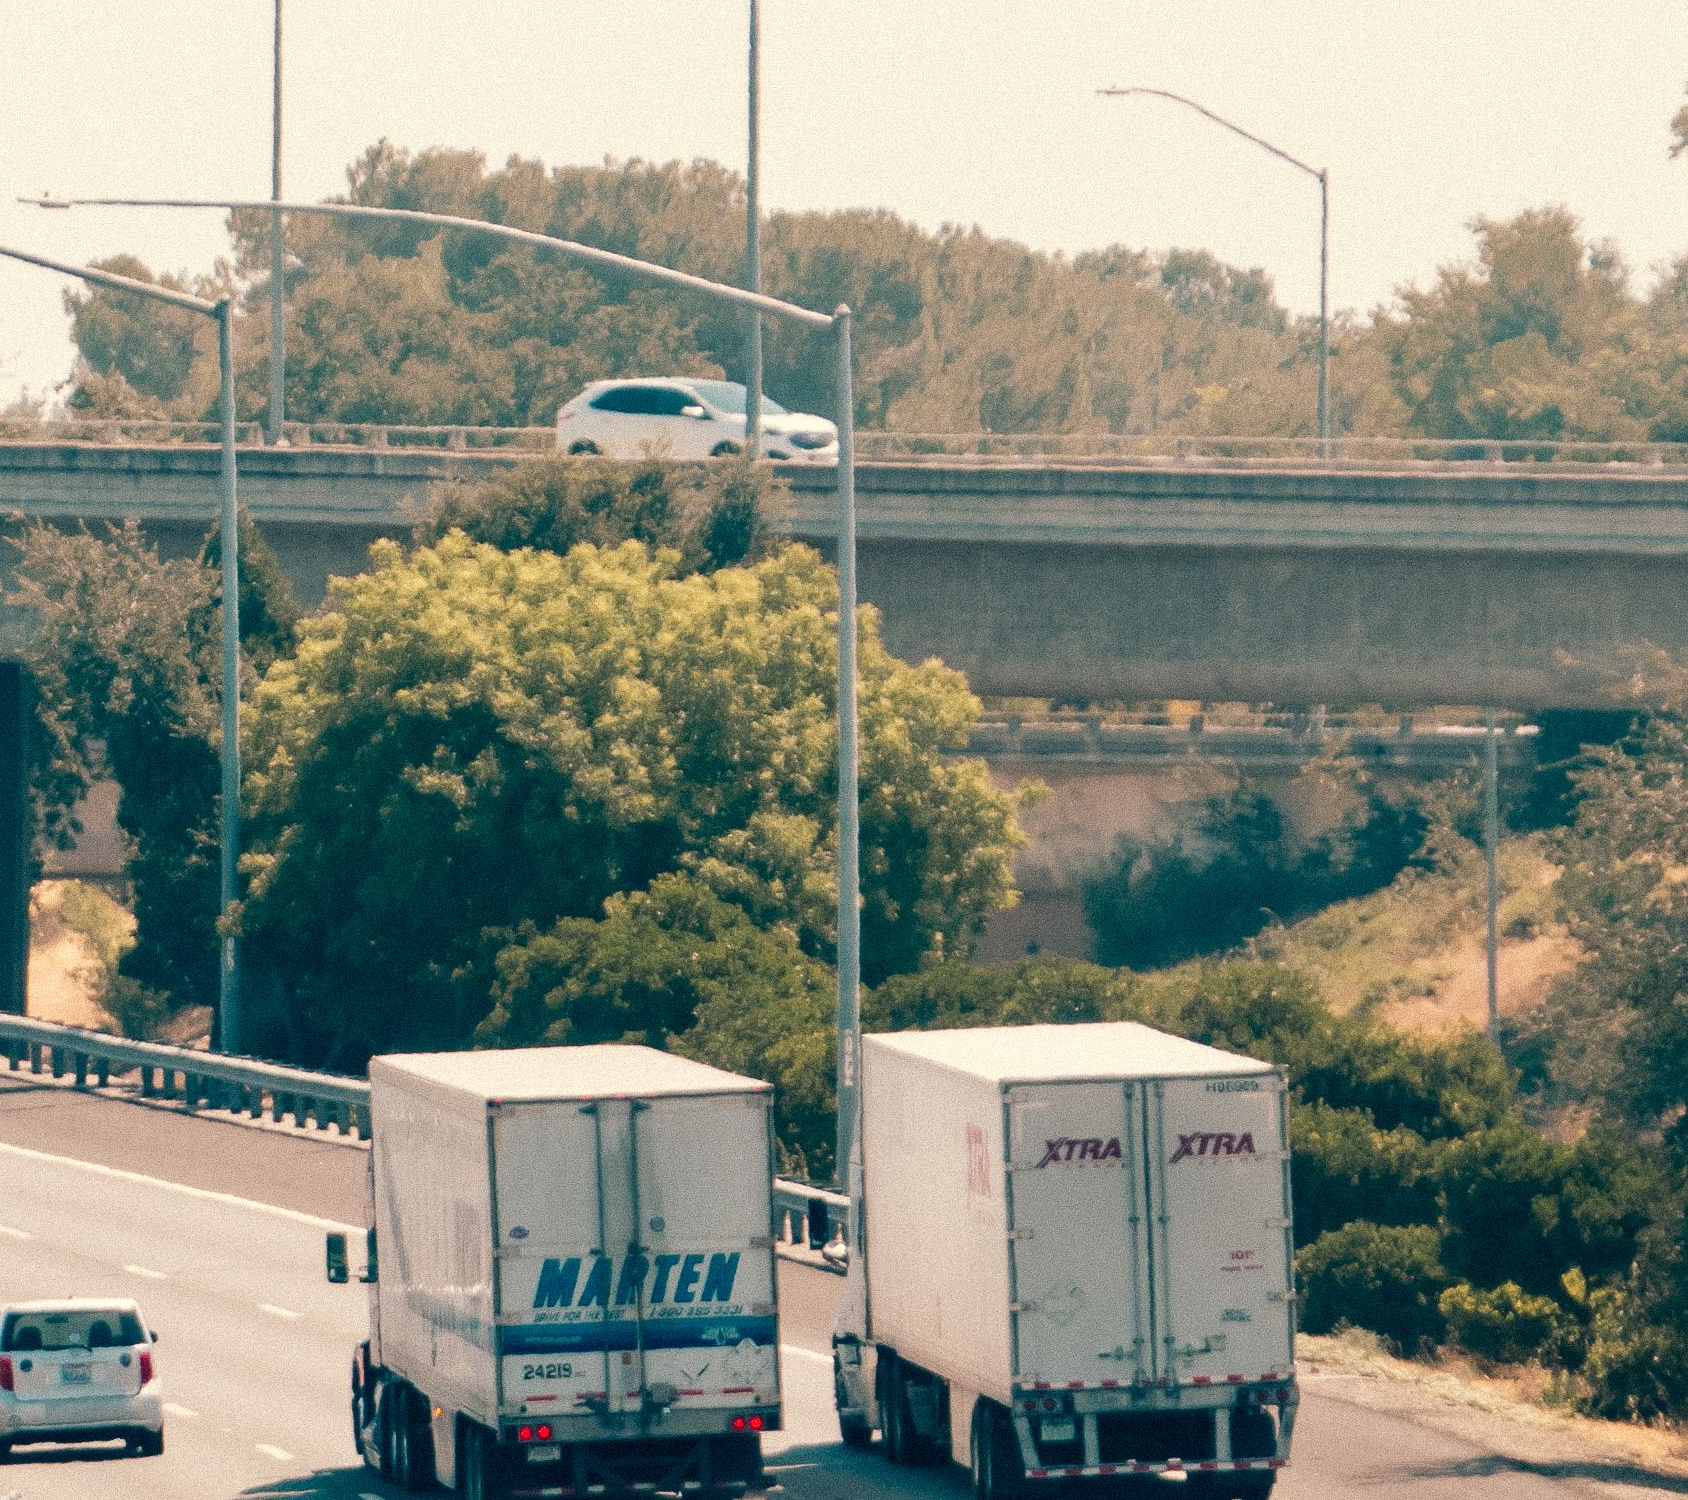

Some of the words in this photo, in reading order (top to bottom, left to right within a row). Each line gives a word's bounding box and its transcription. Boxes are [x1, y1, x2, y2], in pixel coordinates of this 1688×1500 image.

[1035, 1137, 1122, 1169] XTRA
[1168, 1132, 1255, 1164] XTRA
[532, 1252, 741, 1308] MARTEN
[523, 1363, 573, 1380] 24219
